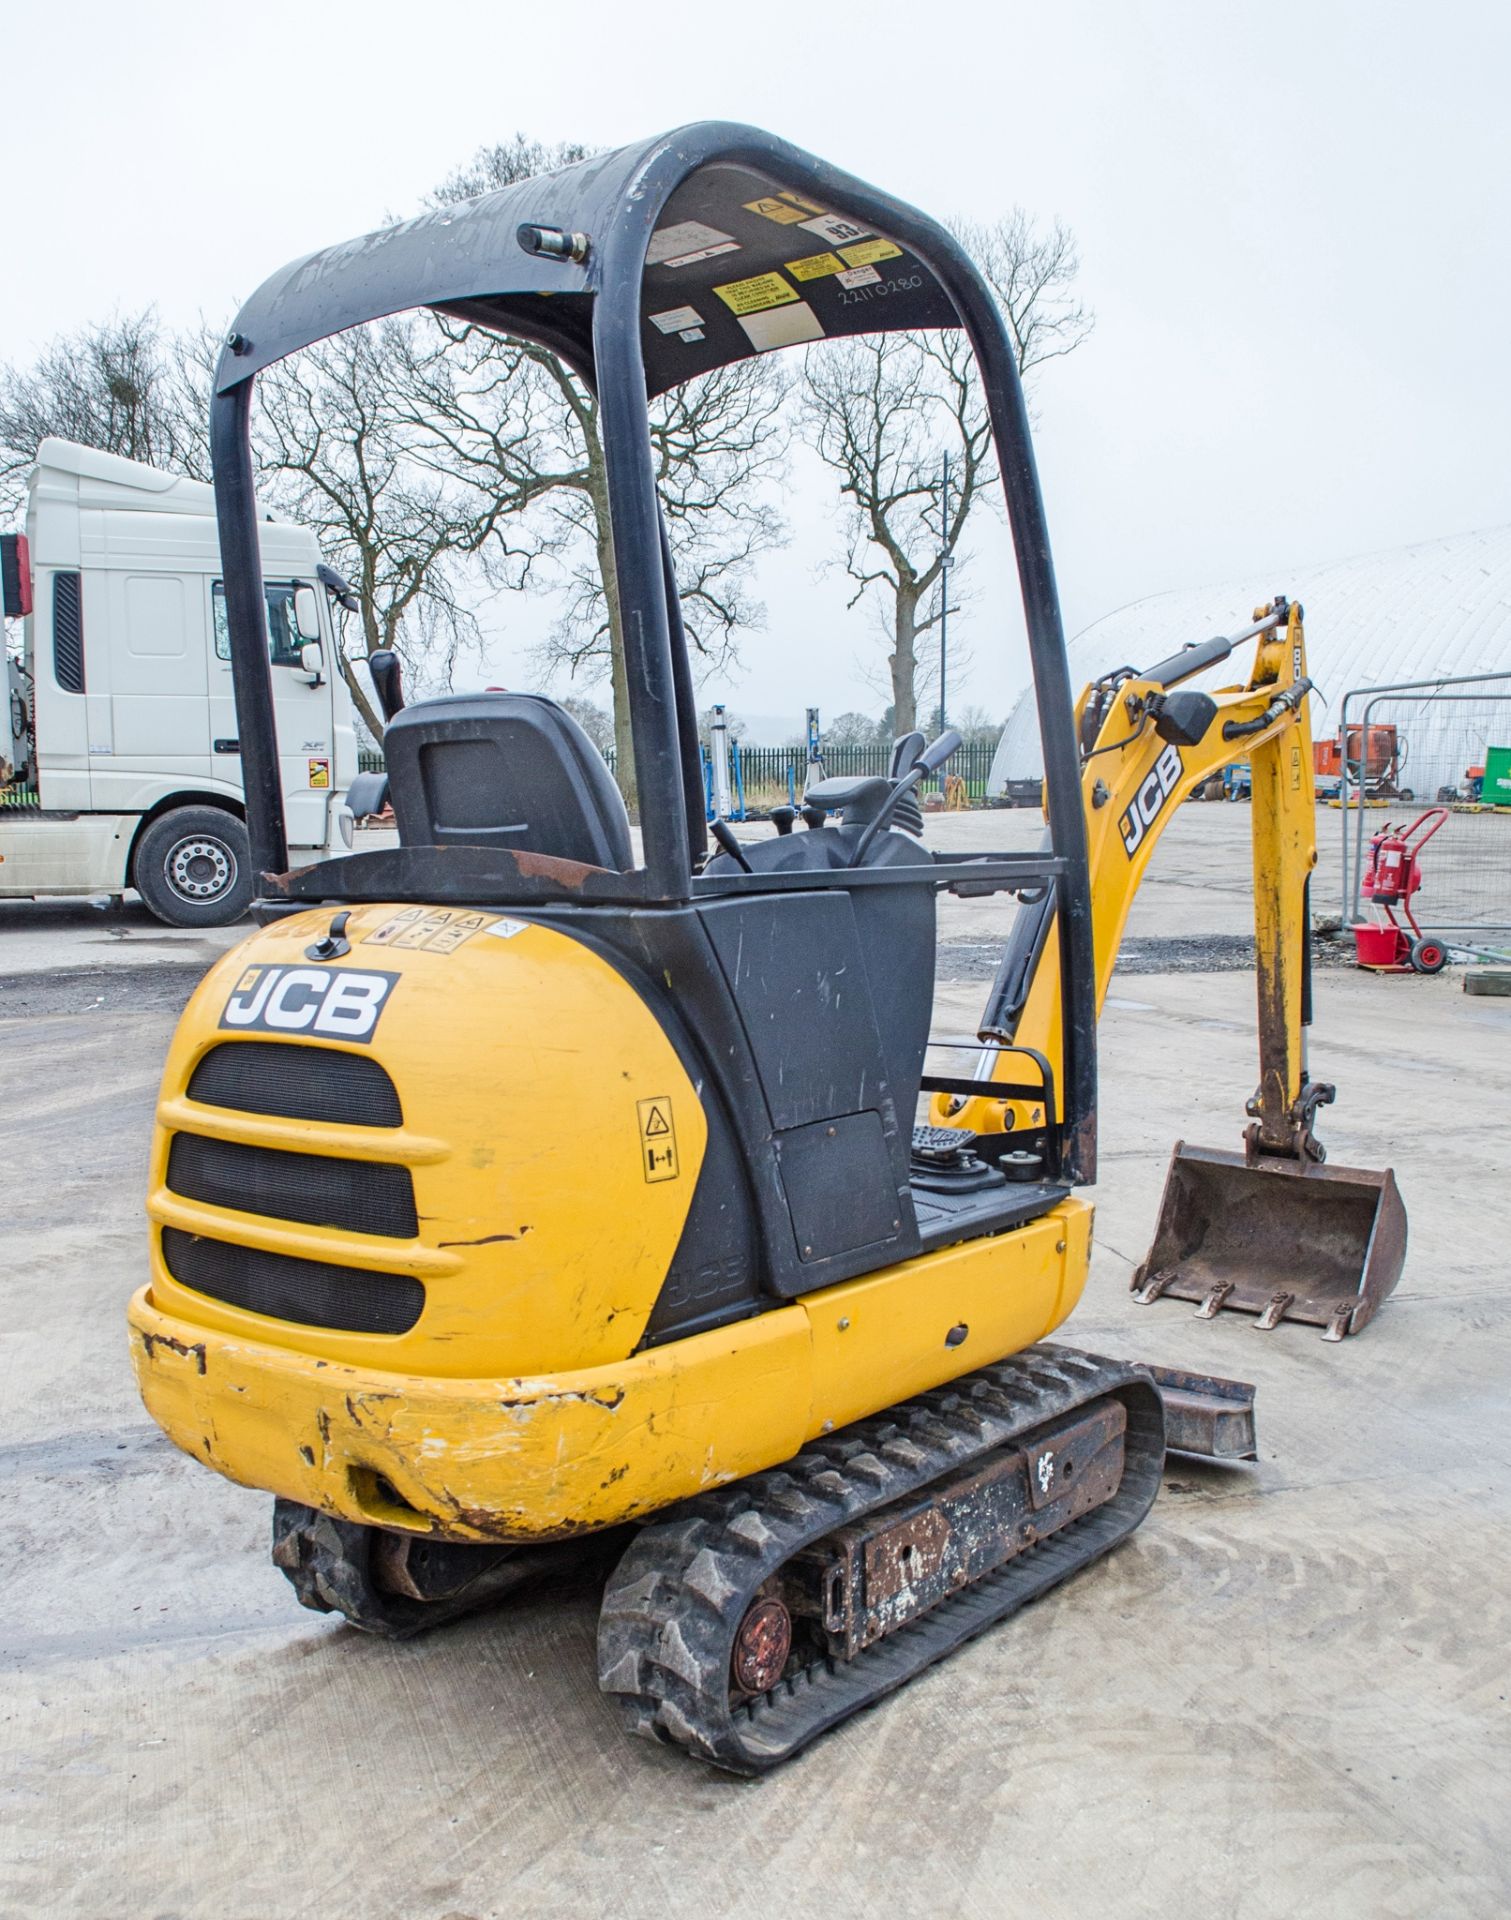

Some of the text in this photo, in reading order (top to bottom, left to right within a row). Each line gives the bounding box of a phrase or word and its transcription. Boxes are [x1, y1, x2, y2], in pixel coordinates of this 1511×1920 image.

[825, 223, 859, 240] 93
[847, 266, 873, 276] Danger
[1125, 743, 1182, 854] JCB
[225, 968, 389, 1036] JCB
[667, 1254, 748, 1308] JCB
